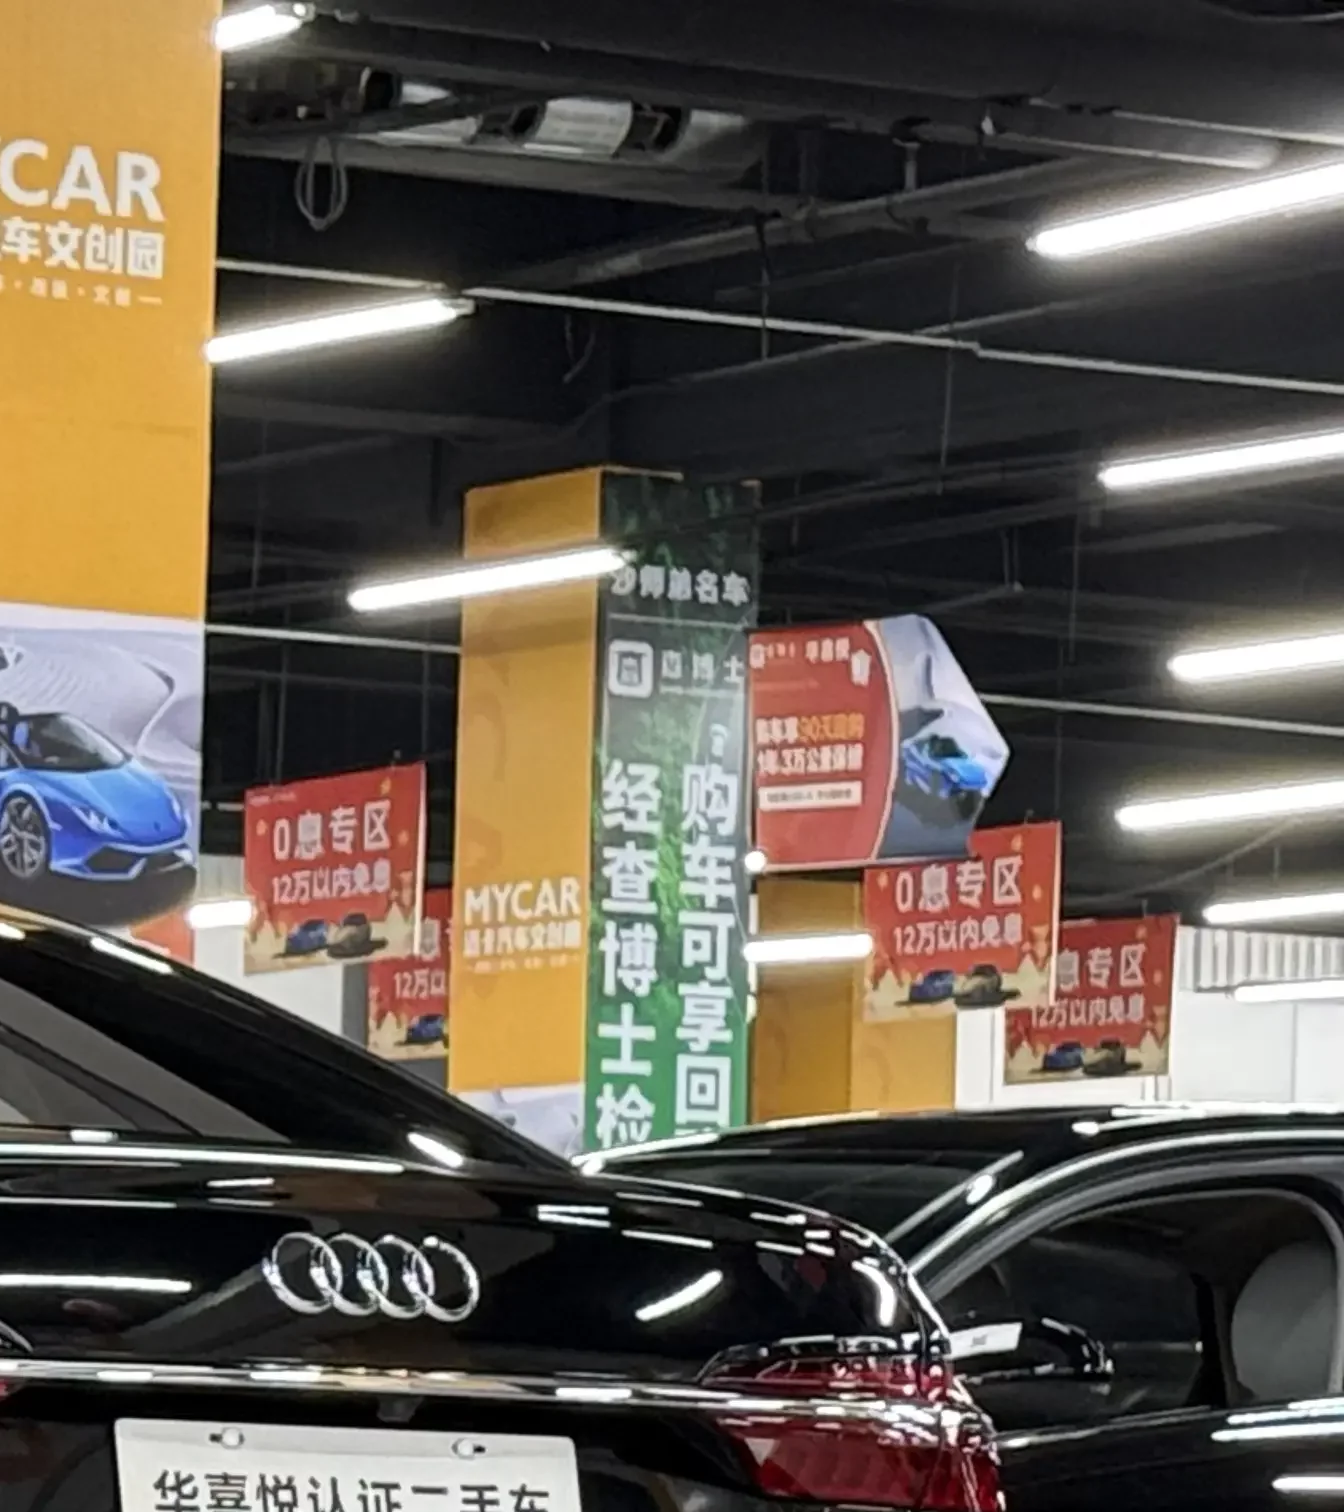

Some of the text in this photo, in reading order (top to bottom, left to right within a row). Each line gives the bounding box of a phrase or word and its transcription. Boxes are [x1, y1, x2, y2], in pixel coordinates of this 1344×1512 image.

[272, 798, 393, 862] 0息专区
[270, 857, 392, 907] 12万以内免息
[462, 875, 584, 927] MYCAR
[894, 854, 1024, 913] 0息专区
[595, 760, 664, 1148] 经查博士检
[676, 760, 740, 1138] 购车可享回
[892, 913, 1024, 958] 12万以内免息
